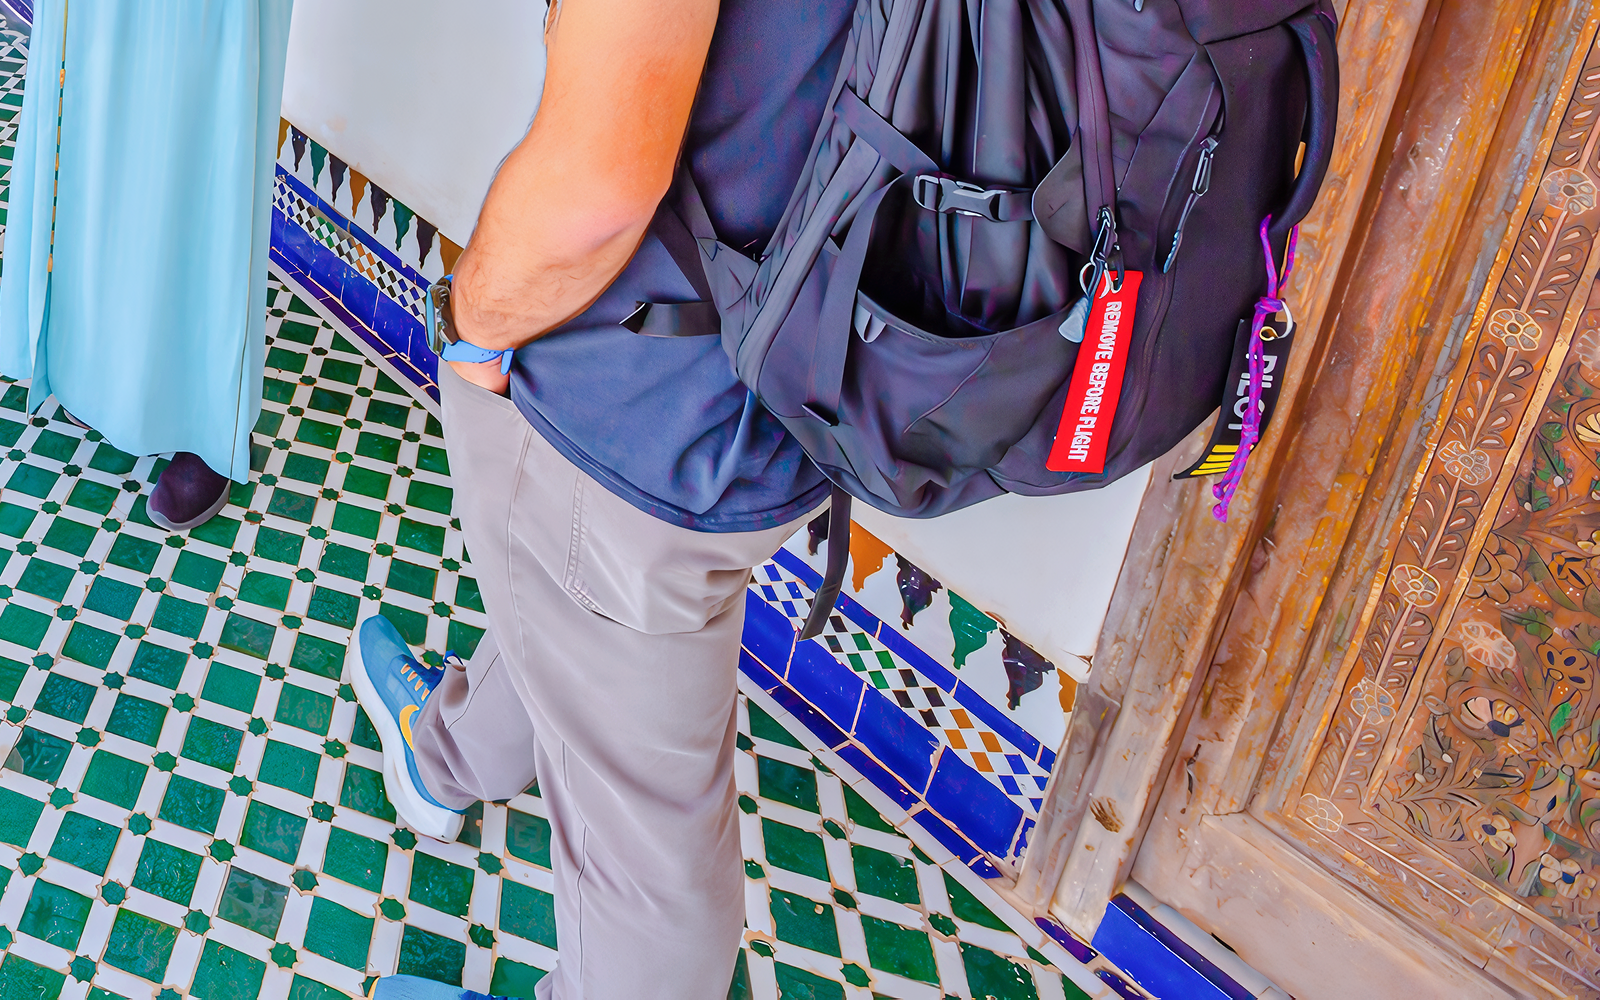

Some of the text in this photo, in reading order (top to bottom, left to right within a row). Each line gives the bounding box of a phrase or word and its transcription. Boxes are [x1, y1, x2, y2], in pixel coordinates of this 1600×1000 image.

[1067, 301, 1123, 462] REMOVE BEFORE FLIGHT
